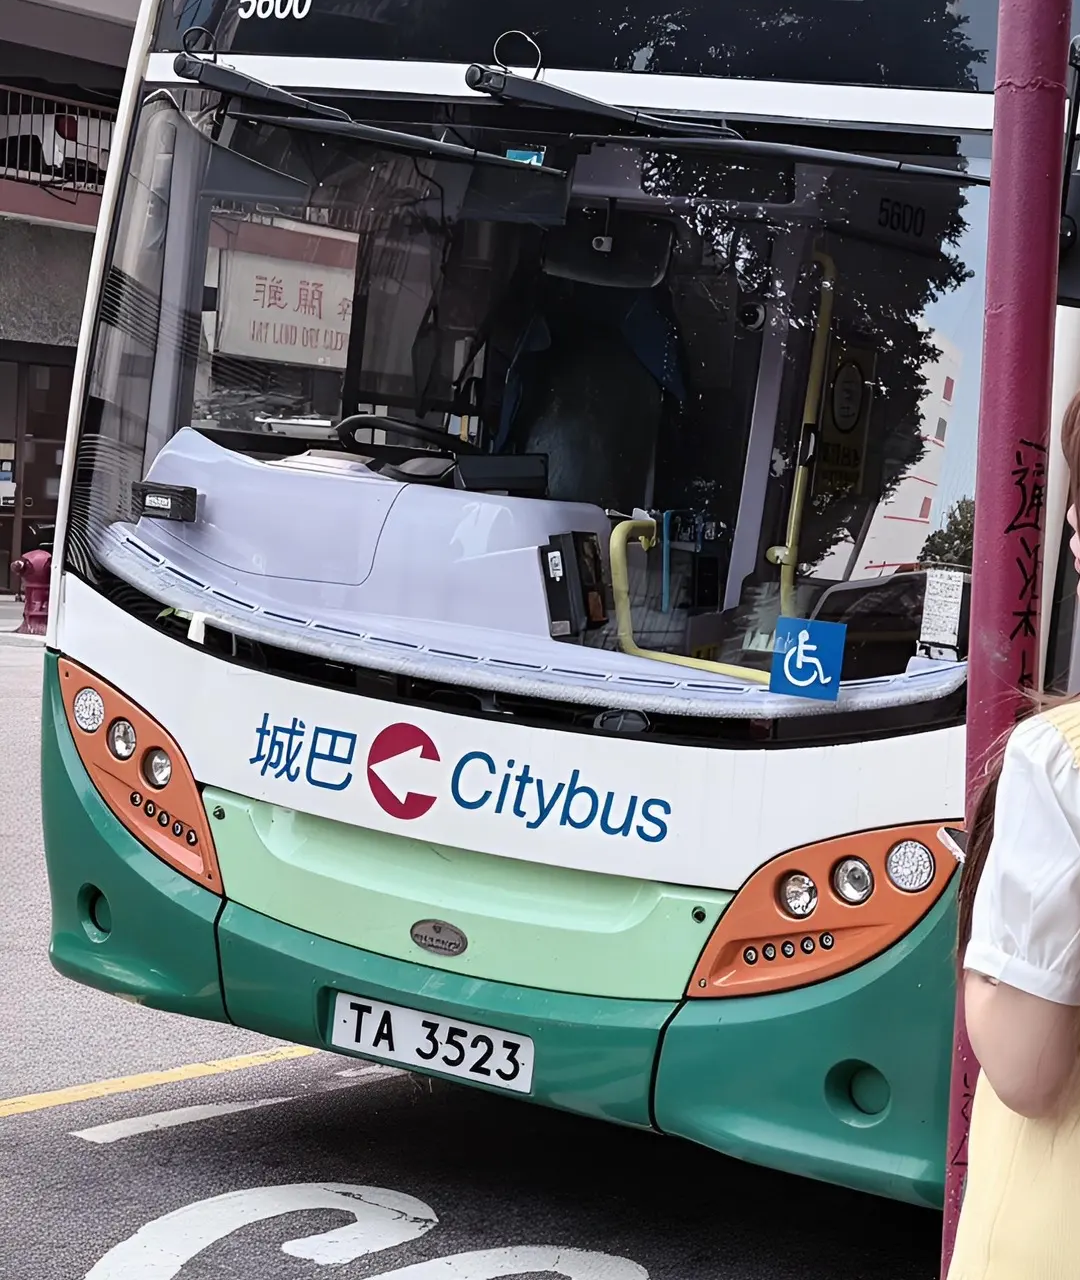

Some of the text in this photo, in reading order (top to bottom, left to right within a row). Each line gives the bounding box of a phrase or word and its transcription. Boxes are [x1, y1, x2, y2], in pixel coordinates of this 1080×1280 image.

[248, 712, 672, 843] 城巴 Citybus
[350, 1001, 521, 1081] TA 3523
